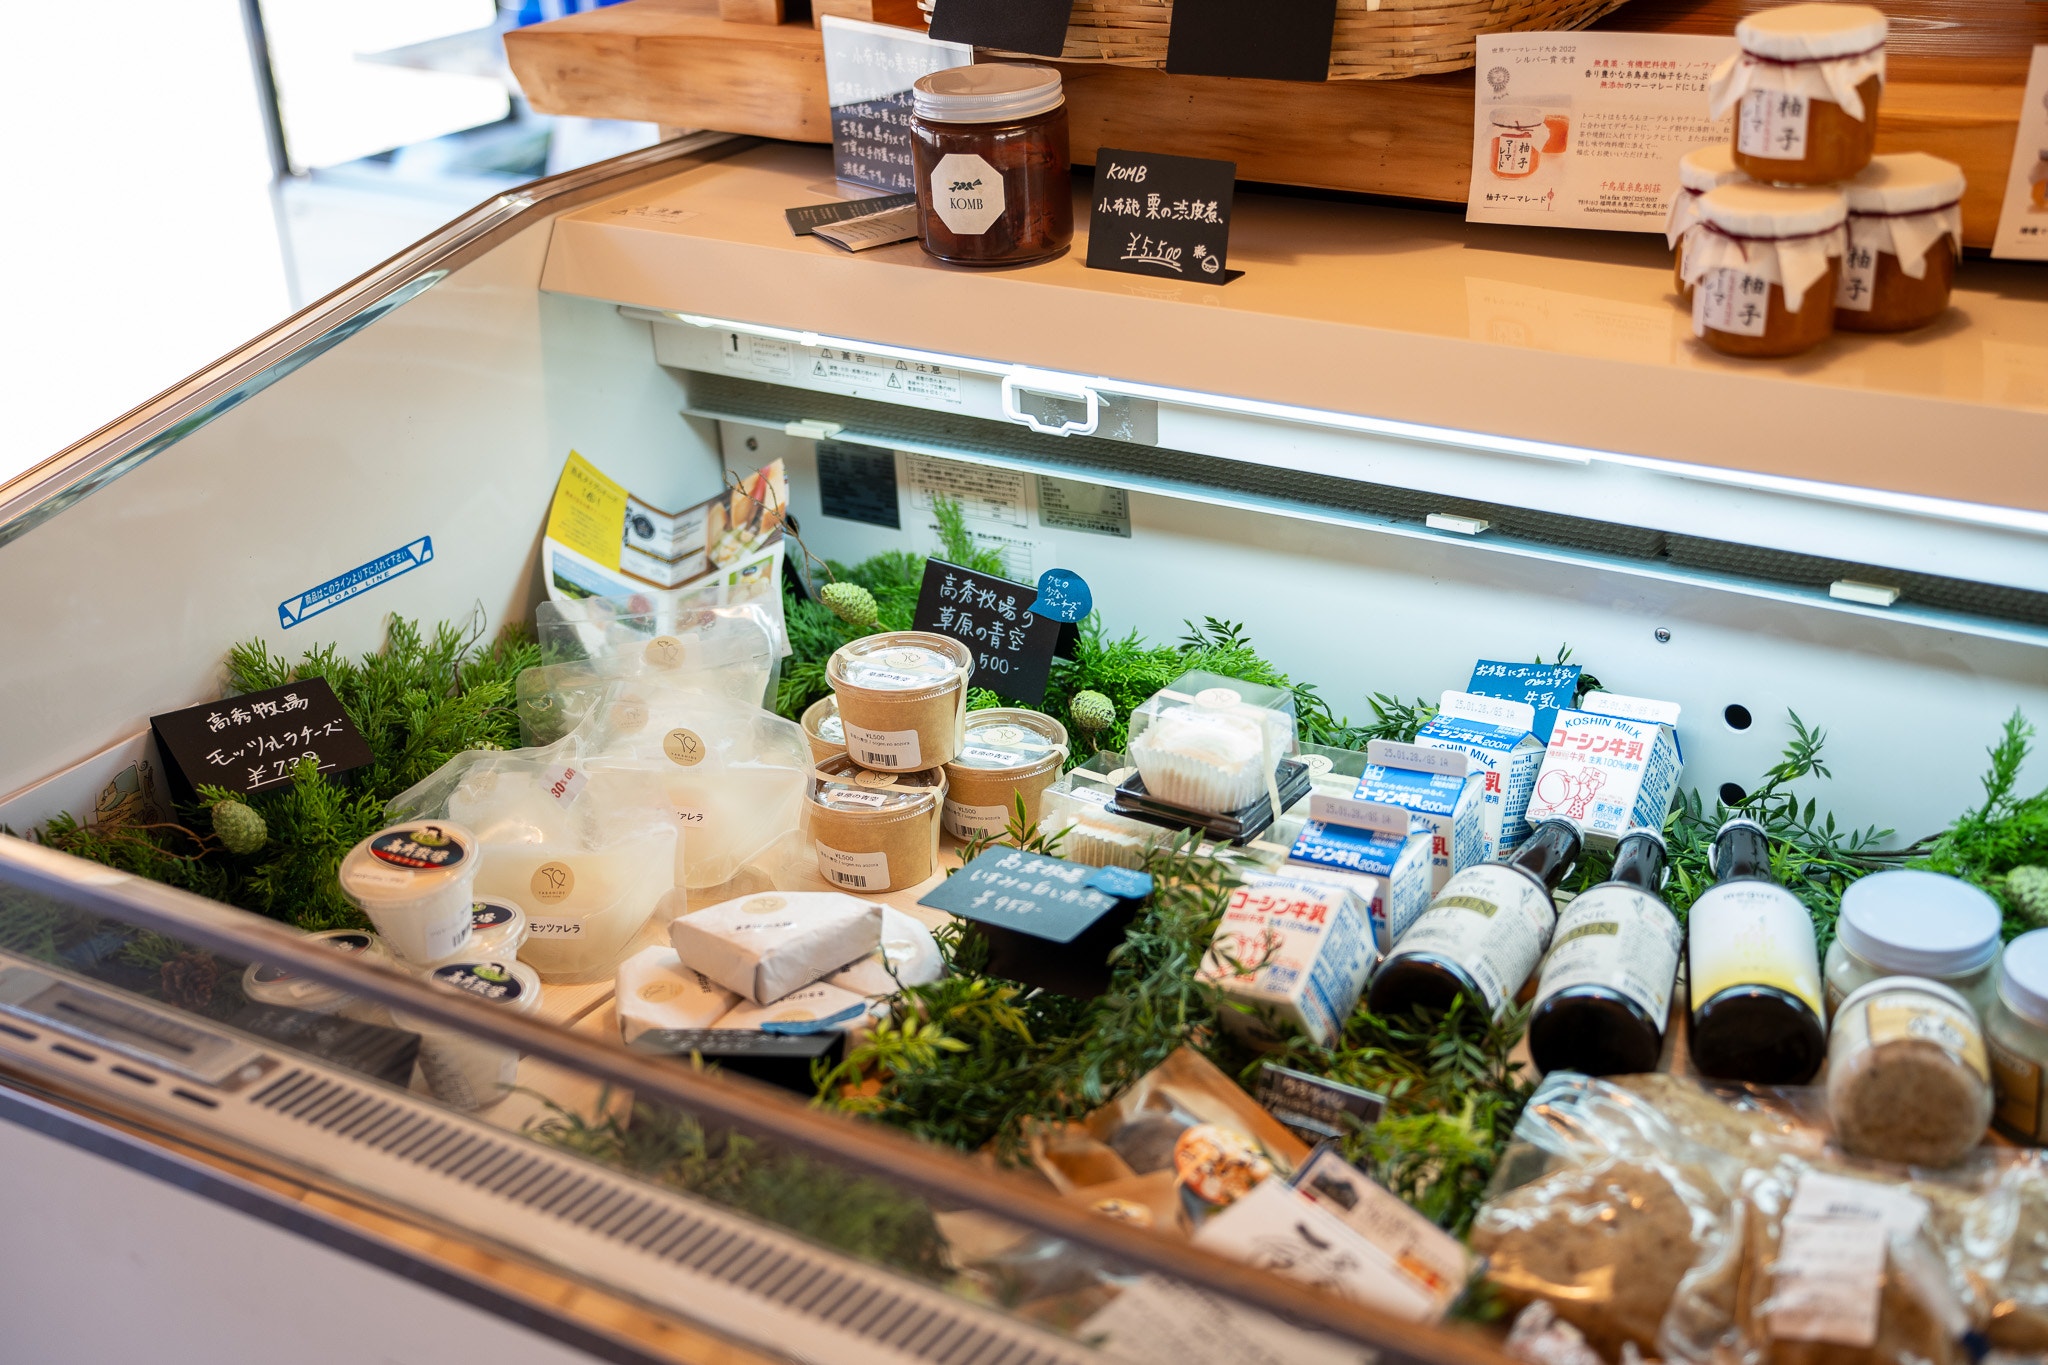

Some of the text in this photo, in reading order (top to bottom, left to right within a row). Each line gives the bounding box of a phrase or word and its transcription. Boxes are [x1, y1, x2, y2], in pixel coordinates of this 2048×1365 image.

[1515, 56, 1576, 64] シルバー賞 受賞
[1585, 69, 1711, 80] 香り豊かな糸島産の柚子をたっぷ
[1600, 81, 1710, 92] 無添加のマーマレードにしま
[1518, 142, 1530, 169] 柚子
[1106, 162, 1148, 183] KOMB
[949, 197, 984, 210] KOMB
[1098, 197, 1141, 217] 小布施
[1486, 193, 1547, 203] 柚子マーマレード
[1126, 232, 1182, 261] ¥5,500
[1846, 247, 1872, 301] 柚子
[1738, 275, 1766, 327] 柚子
[304, 551, 408, 606] 商品はこのラインより下に入れて下さい
[327, 570, 391, 605] LOAD LINE
[940, 573, 1034, 629] 高秀牧場の
[932, 605, 1026, 652] 草原の青空
[206, 692, 310, 733] 高秀牧場
[1565, 716, 1642, 739] KOSHIN MILK
[1550, 728, 1645, 762] コーシン牛乳
[1469, 748, 1498, 769] MILK
[1569, 751, 1586, 763] 牛乳
[551, 779, 568, 798] 30%
[835, 791, 879, 801] 草原の青空
[1230, 891, 1329, 924] コーシン牛乳
[529, 923, 581, 934] モッツァレラ
